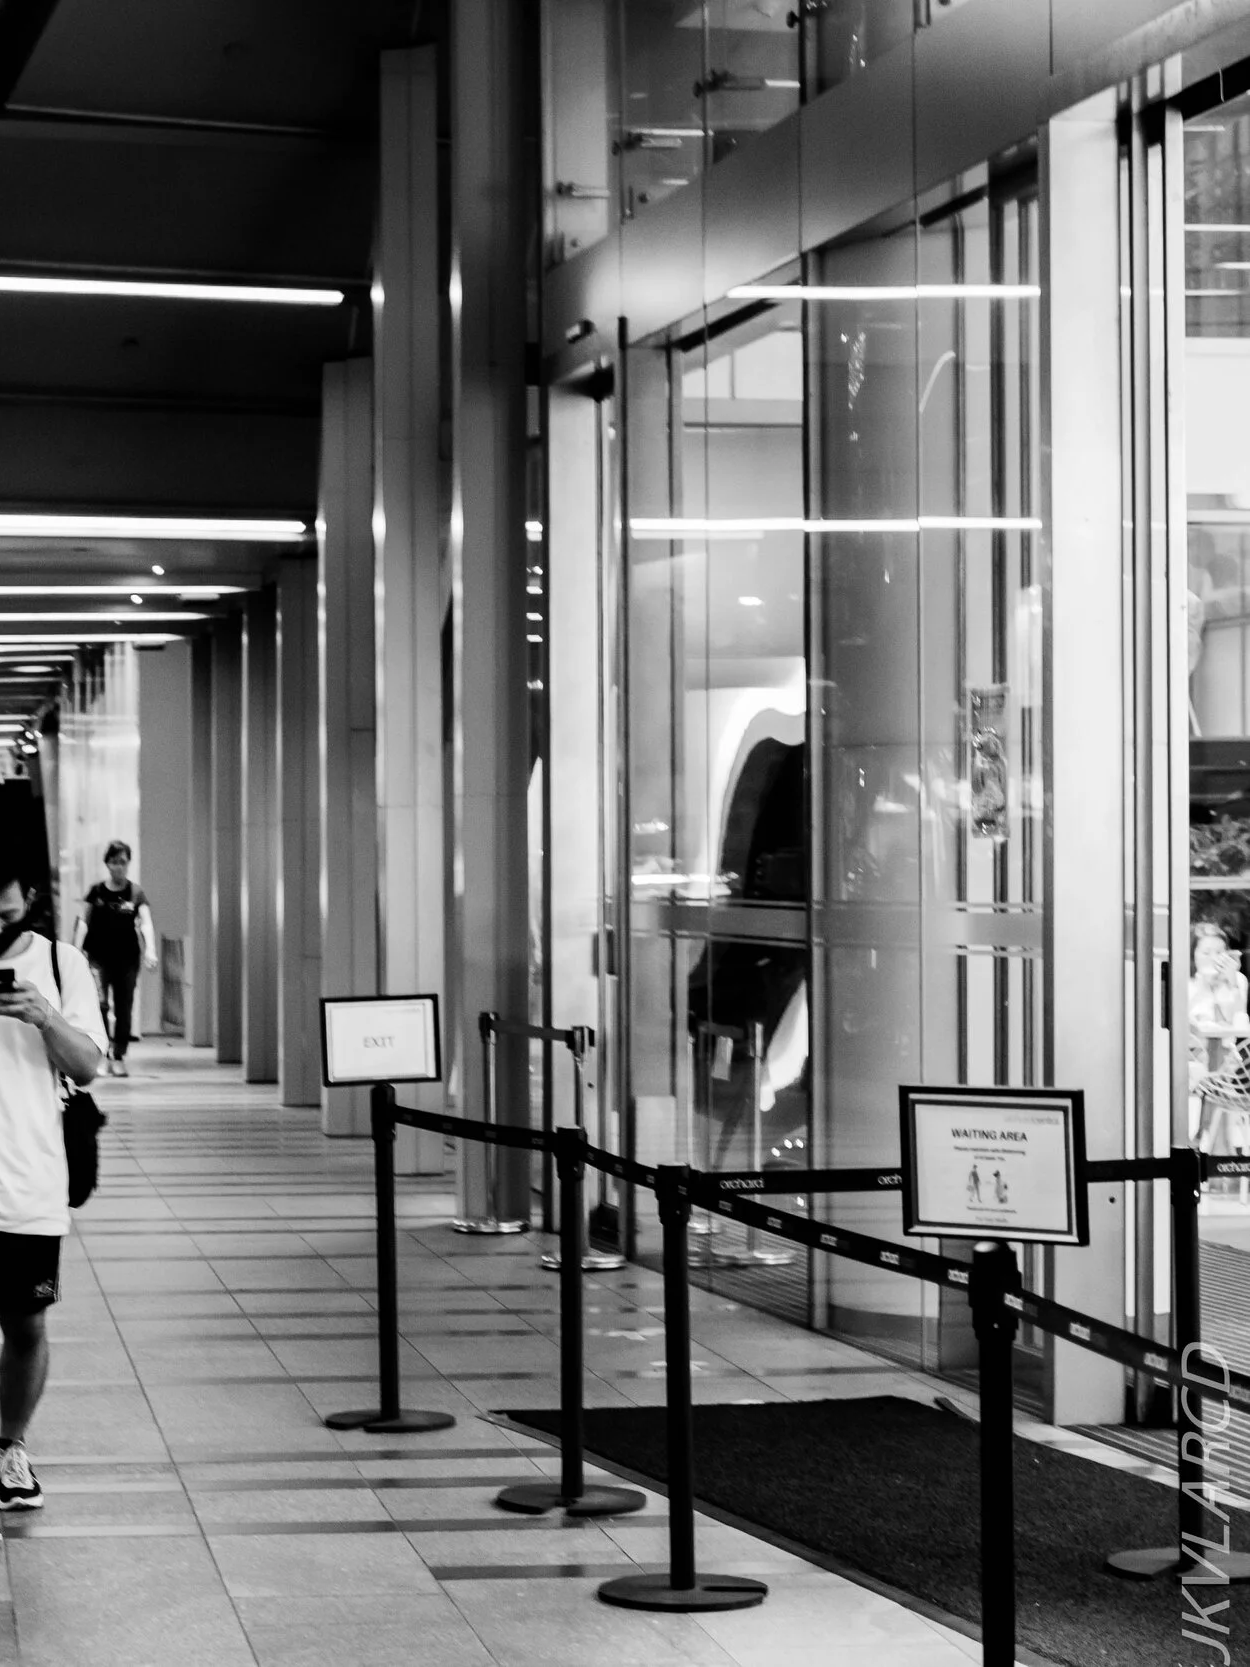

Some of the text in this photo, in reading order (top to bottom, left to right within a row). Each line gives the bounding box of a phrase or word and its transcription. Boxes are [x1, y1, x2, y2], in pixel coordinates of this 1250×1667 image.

[362, 1035, 395, 1049] EXIT
[951, 1127, 1029, 1143] WAITING AREA
[719, 1176, 765, 1190] orchard
[877, 1173, 902, 1186] orch
